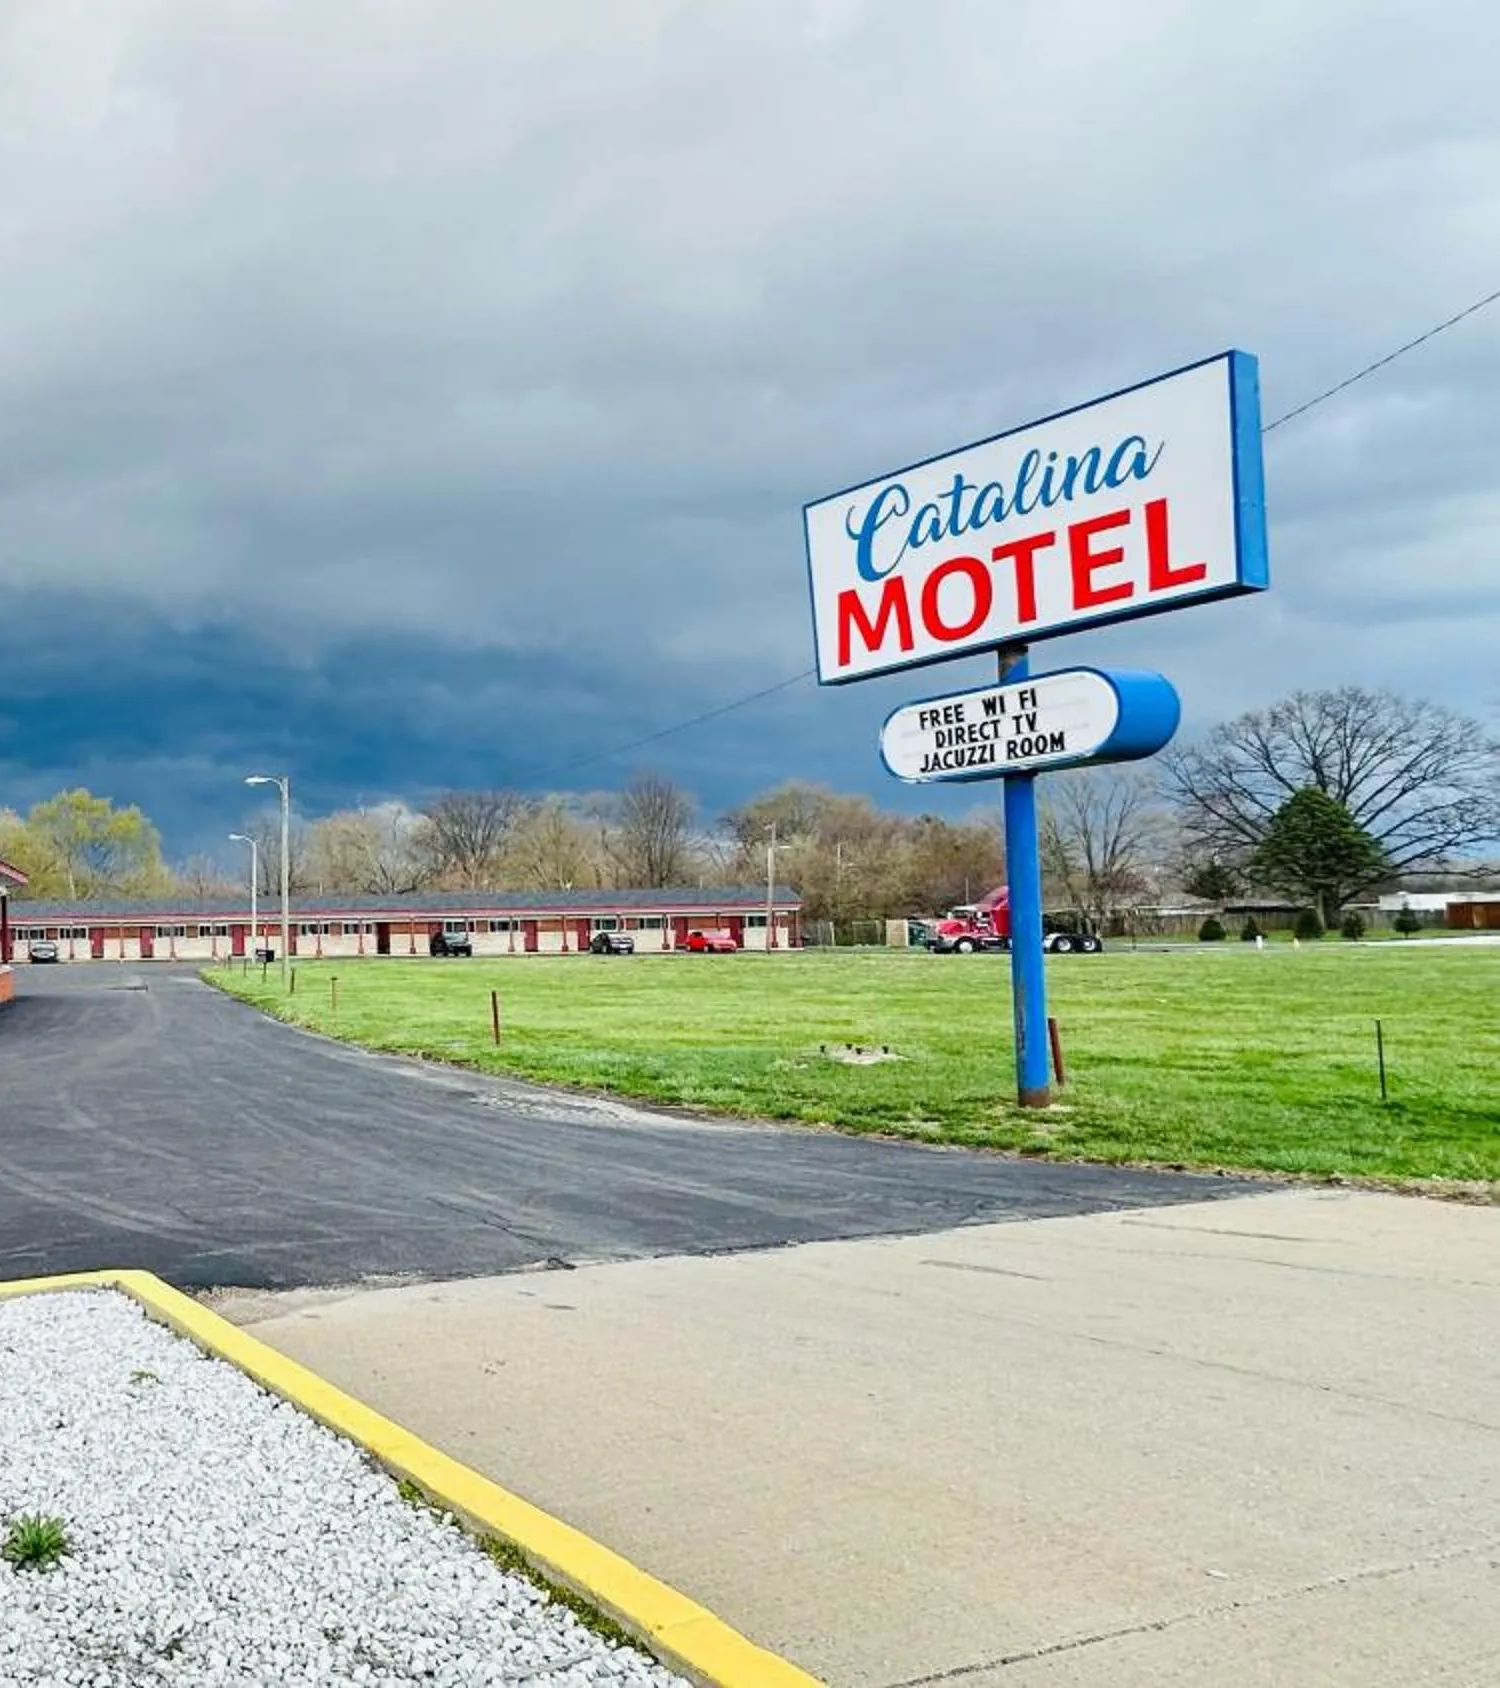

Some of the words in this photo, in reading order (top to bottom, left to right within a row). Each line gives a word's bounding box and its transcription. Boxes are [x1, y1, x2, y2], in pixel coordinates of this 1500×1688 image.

[846, 435, 1164, 582] Catalina
[838, 498, 1206, 666] MOTEL
[919, 704, 964, 731] FREE
[982, 695, 1005, 717] WI
[1019, 688, 1037, 710] FI
[935, 720, 1001, 748] DIRECT
[1012, 712, 1037, 734] TV
[920, 744, 995, 772] JACUZZI
[1007, 732, 1065, 760] ROOM
